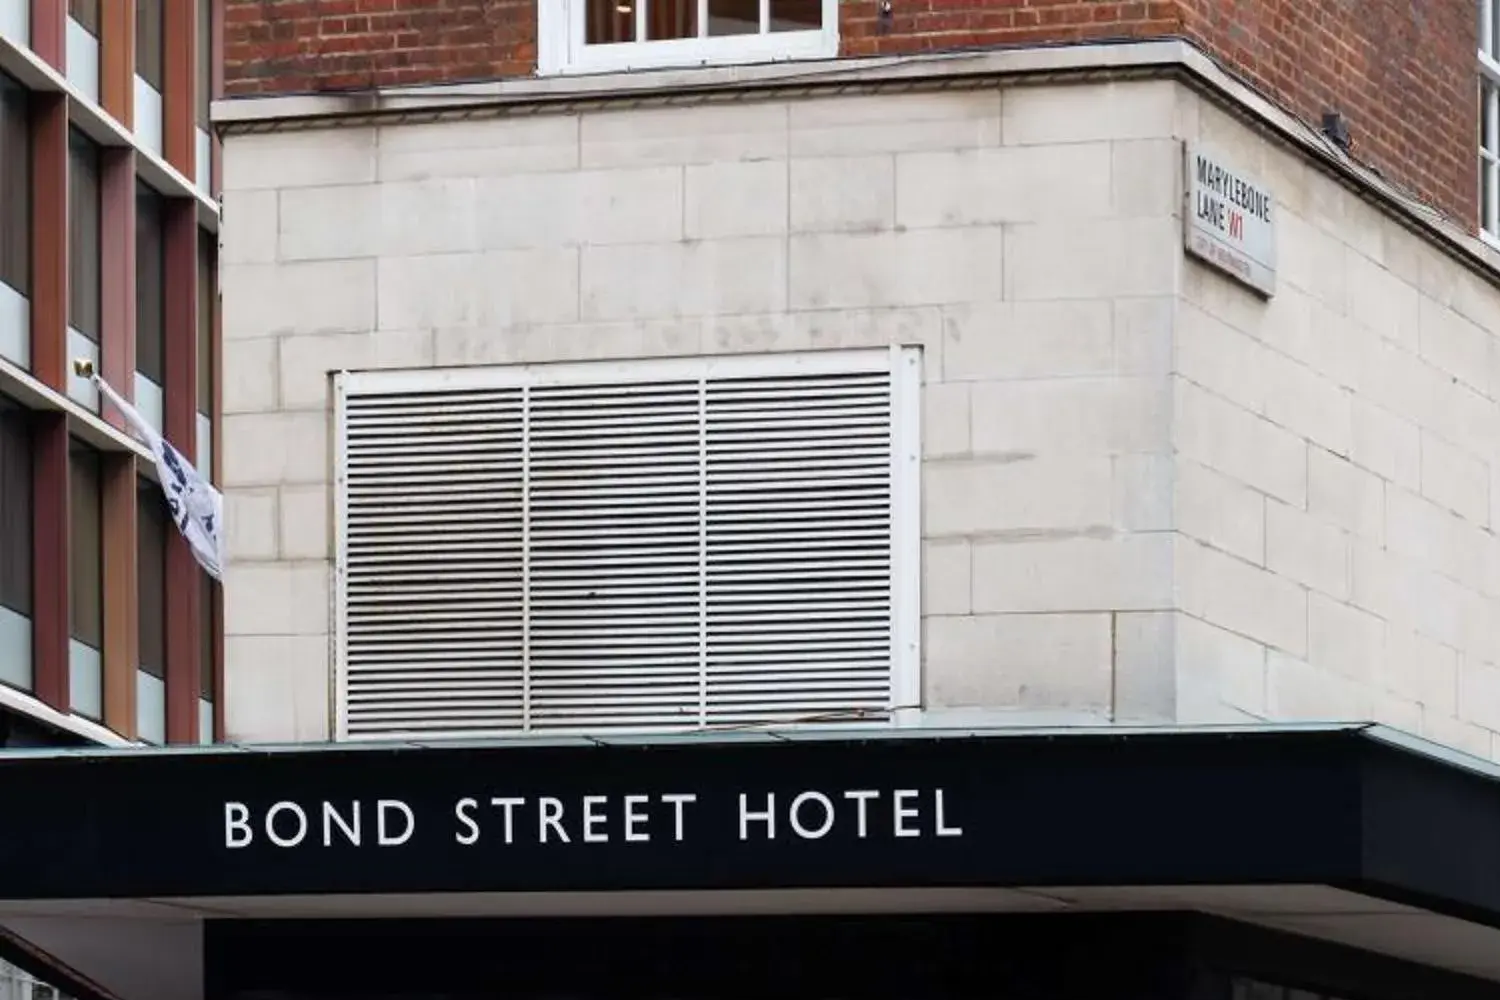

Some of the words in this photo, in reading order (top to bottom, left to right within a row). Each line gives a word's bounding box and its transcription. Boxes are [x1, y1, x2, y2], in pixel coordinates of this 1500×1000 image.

[1197, 155, 1270, 222] MARYLEBONE
[1197, 189, 1225, 230] LANE
[1228, 208, 1243, 240] W1
[224, 800, 415, 848] BOND
[455, 794, 697, 845] STREET
[739, 788, 963, 839] HOTEL
